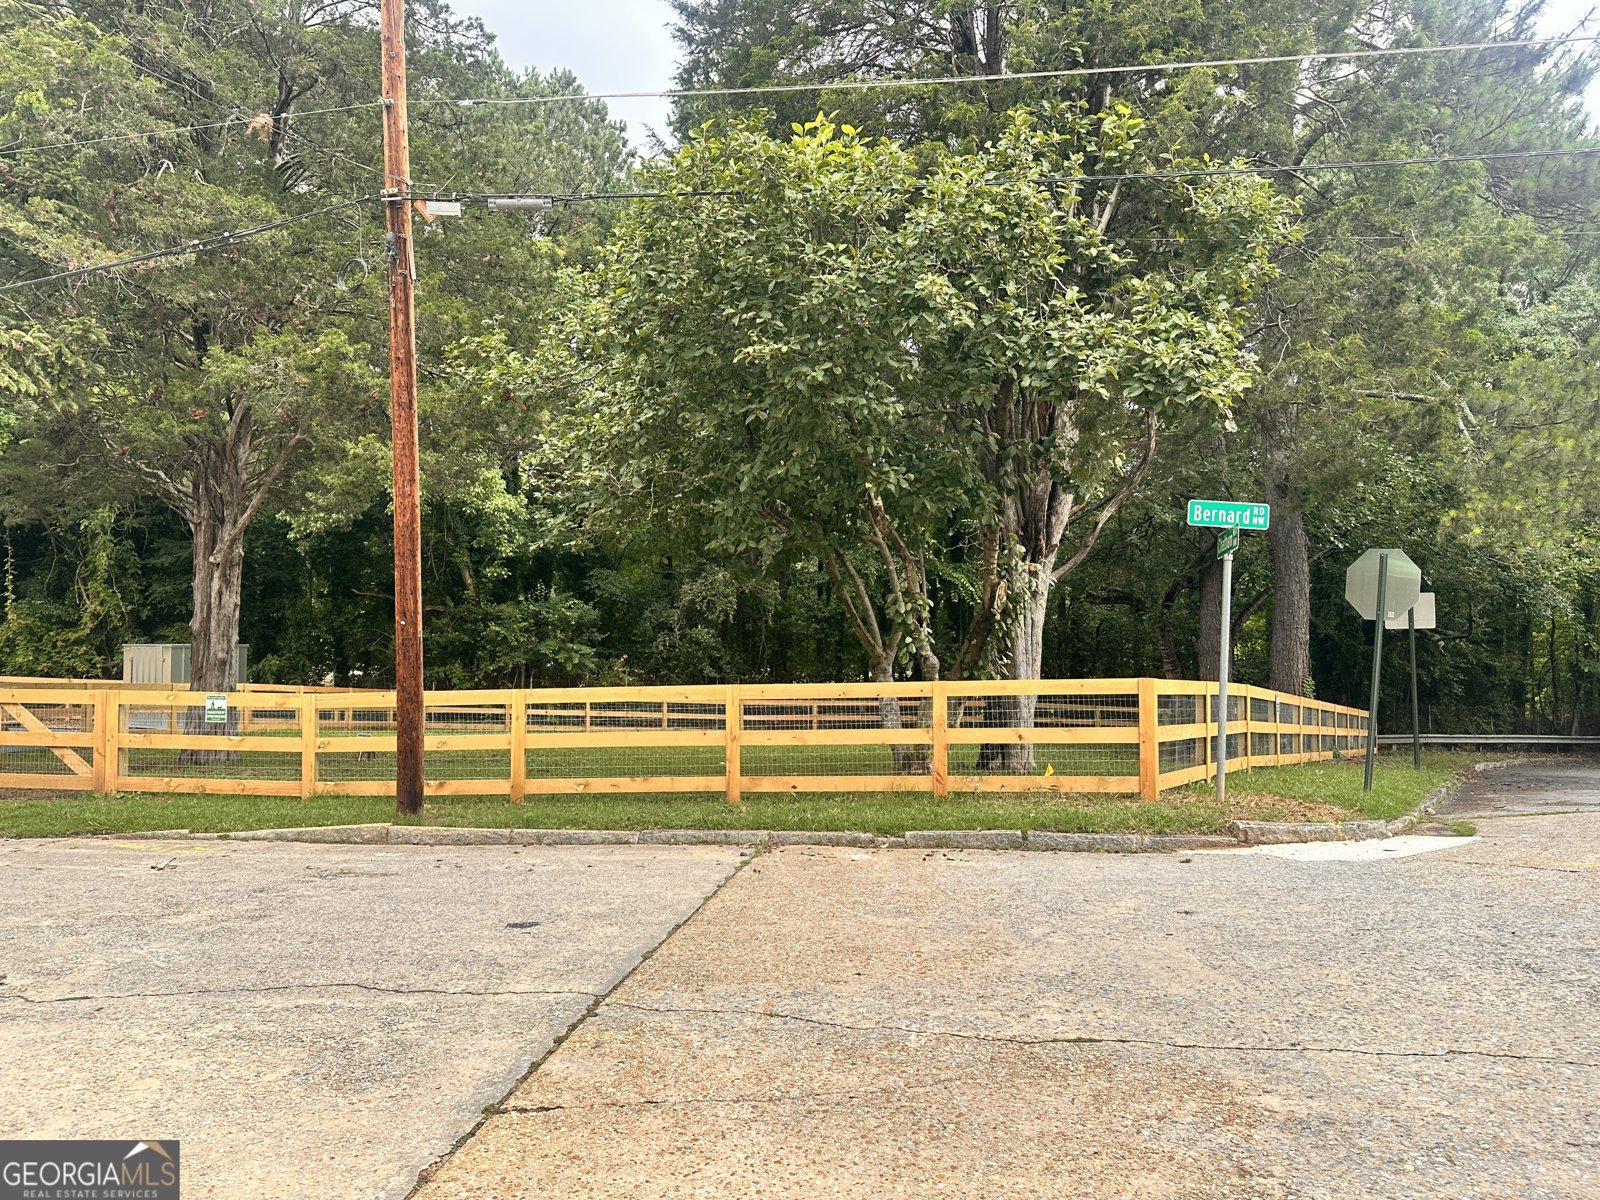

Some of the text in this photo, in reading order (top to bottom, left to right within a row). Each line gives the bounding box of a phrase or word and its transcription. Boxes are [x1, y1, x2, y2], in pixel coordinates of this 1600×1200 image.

[1193, 504, 1265, 525] Bernard RD
[1252, 516, 1265, 525] NW
